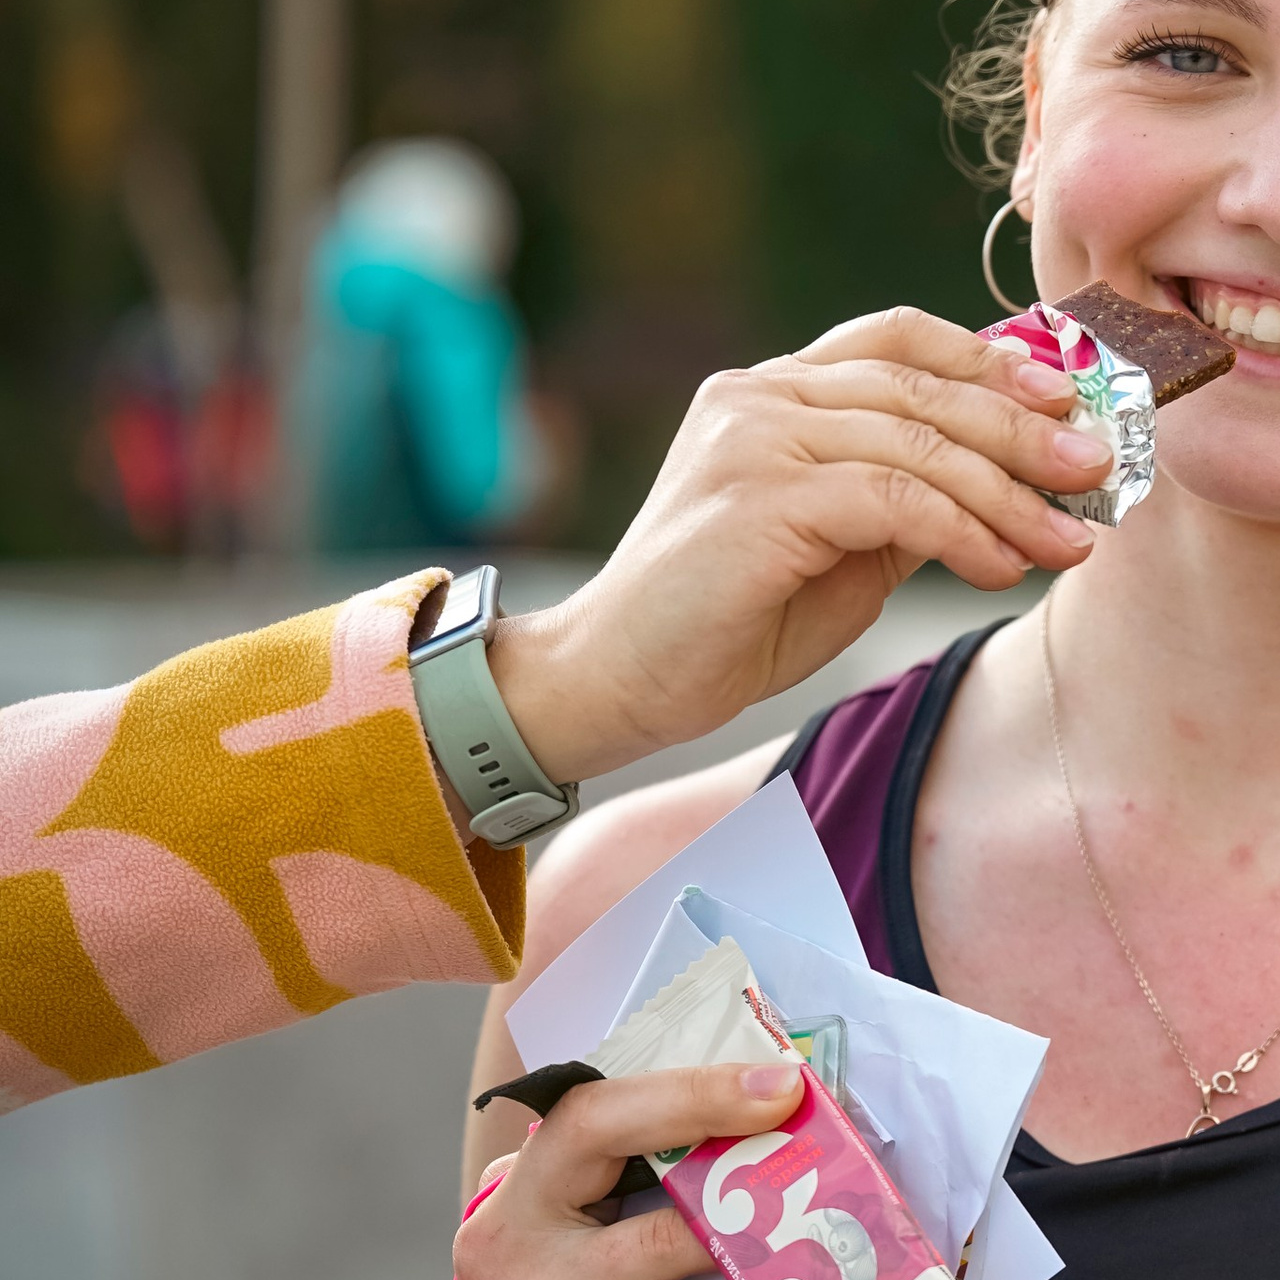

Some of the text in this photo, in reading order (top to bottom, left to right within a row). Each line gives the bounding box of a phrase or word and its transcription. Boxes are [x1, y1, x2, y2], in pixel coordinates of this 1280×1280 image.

[745, 1133, 816, 1189] клюква
[770, 1147, 825, 1189] орехи
[708, 1234, 723, 1261] №
